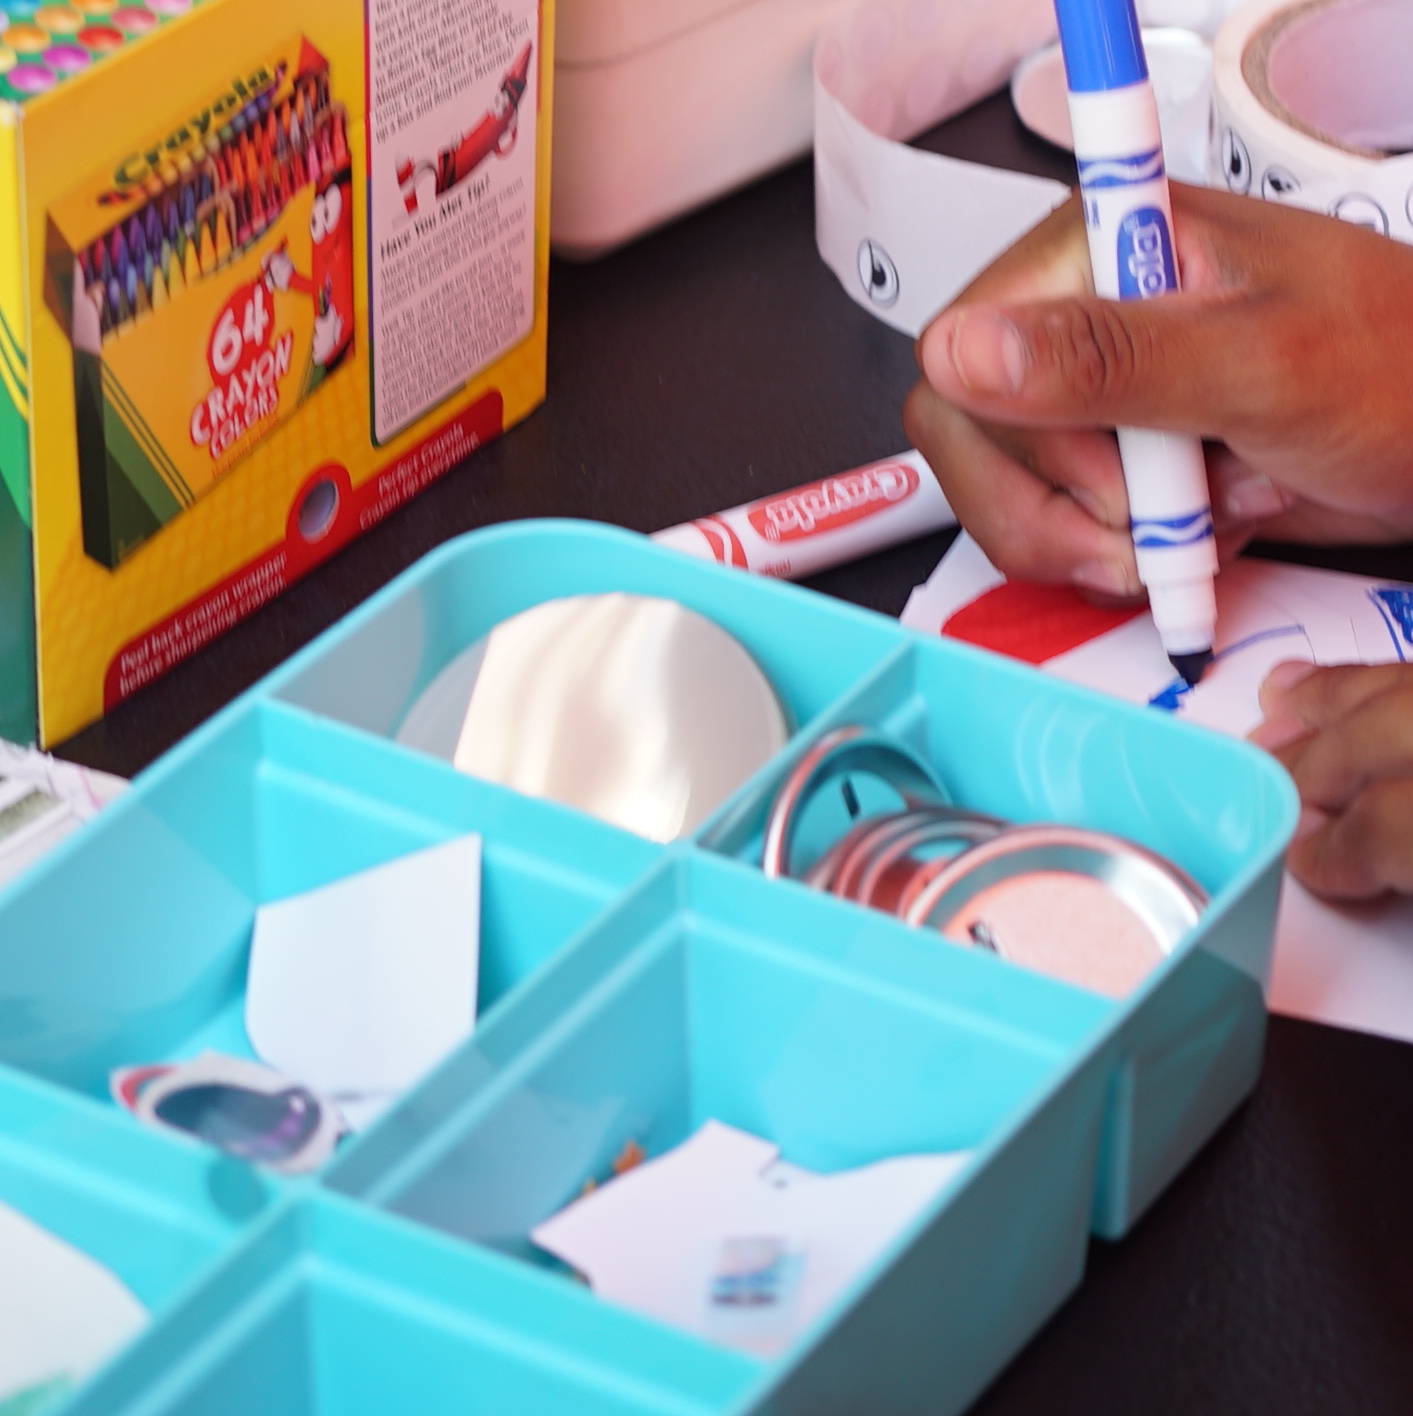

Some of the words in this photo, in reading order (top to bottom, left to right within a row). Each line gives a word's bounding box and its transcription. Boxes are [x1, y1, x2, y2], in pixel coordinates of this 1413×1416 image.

[112, 68, 271, 188] Crayola
[211, 283, 270, 377] 64
[189, 330, 294, 447] CRAYON
[209, 383, 279, 461] COLORS
[764, 461, 909, 533] Crayola
